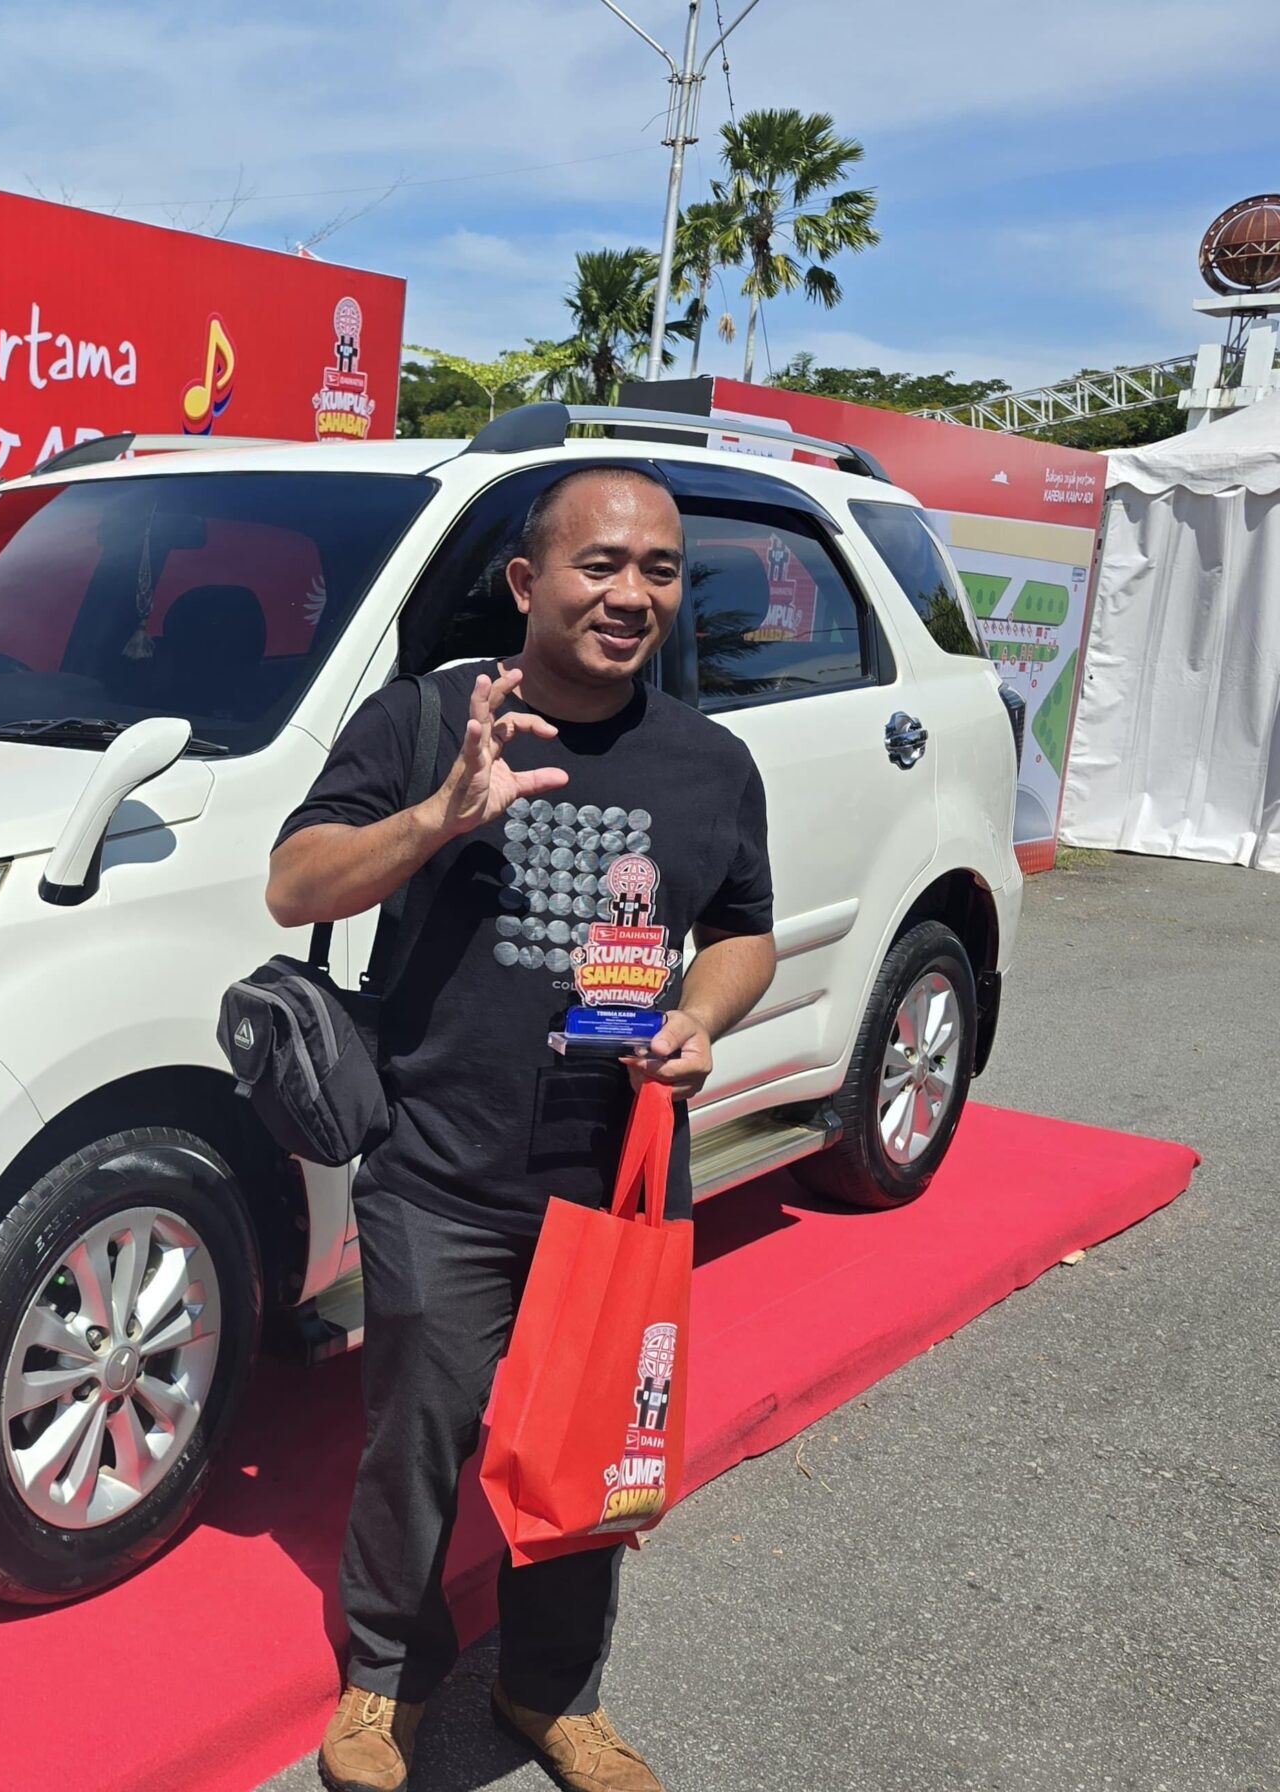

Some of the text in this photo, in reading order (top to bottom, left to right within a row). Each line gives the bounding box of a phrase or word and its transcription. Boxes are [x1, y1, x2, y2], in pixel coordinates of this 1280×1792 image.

[321, 390, 368, 415] KUMPUL
[318, 413, 368, 437] SAHABAT
[619, 930, 660, 940] DAIHATSU
[589, 945, 665, 967] KUMPUL
[582, 966, 667, 988] SAHABAT
[586, 989, 654, 1004] PONTIANAK
